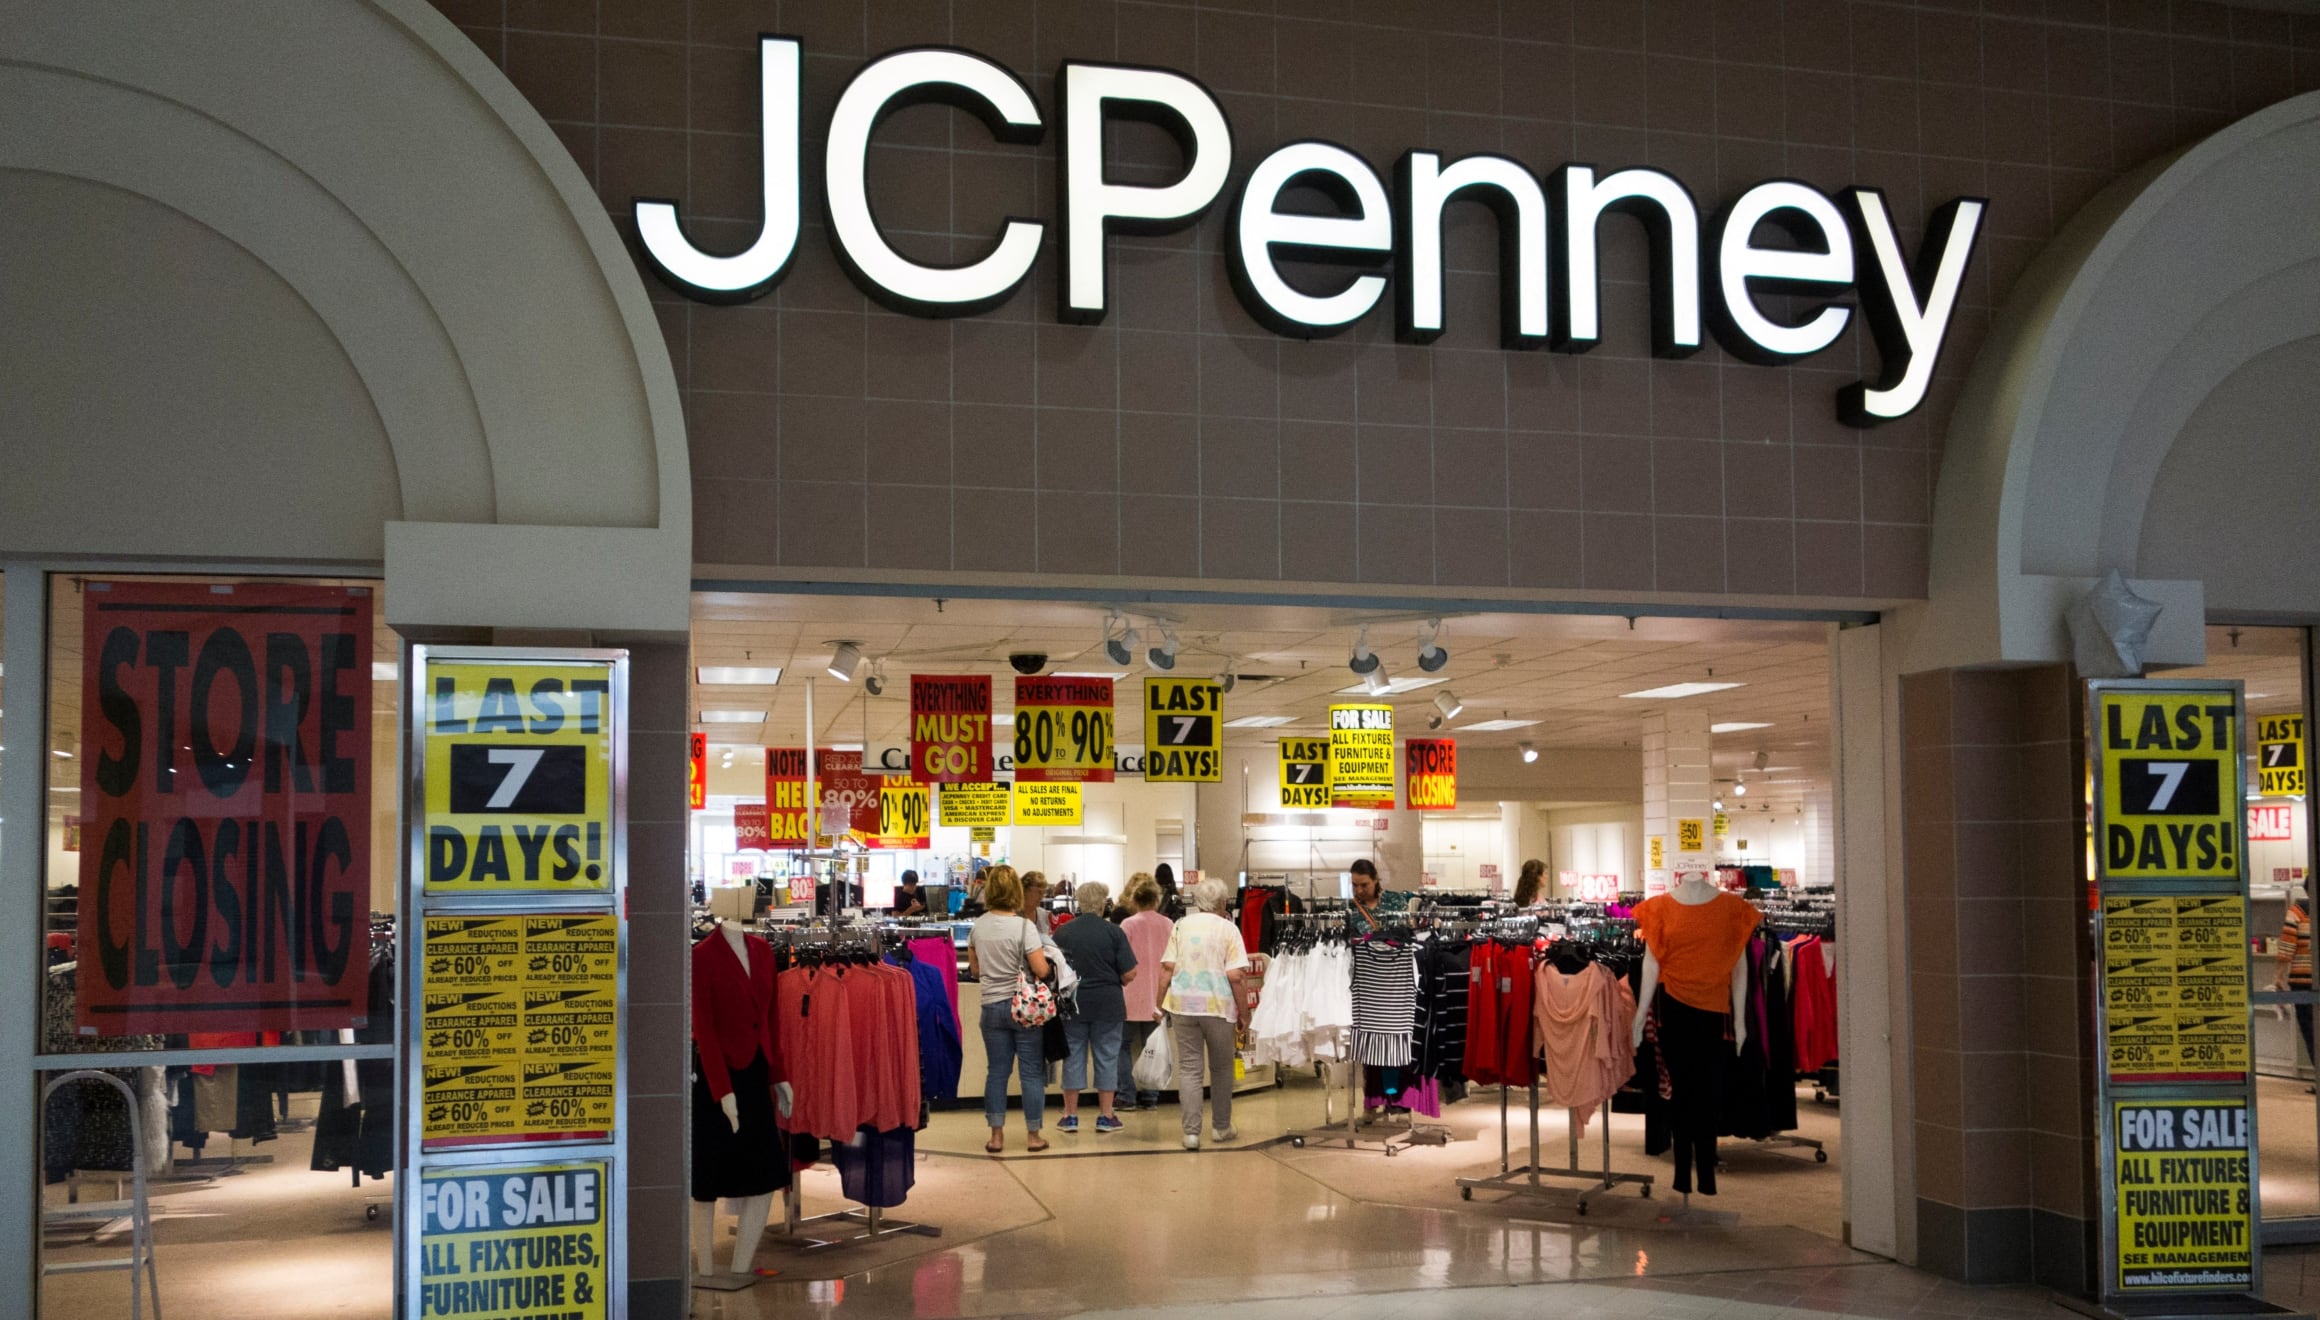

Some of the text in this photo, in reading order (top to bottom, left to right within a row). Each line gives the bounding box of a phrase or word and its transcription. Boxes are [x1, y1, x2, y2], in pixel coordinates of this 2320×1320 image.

[634, 37, 1988, 421] JCPenney
[914, 682, 987, 712] EVERYTHING
[1017, 684, 1110, 701] EVERYTHING
[1150, 685, 1221, 711] LAST
[96, 626, 357, 798] STORE
[435, 677, 609, 735] LAST
[915, 714, 988, 743] MUST
[1332, 710, 1392, 729] FOR SALE
[2107, 704, 2236, 750] LAST
[1172, 716, 1197, 744] 7
[2257, 718, 2304, 741] LAST
[1332, 733, 1349, 745] ALL
[825, 754, 846, 763] RED
[924, 745, 978, 775] GO!
[1282, 742, 1330, 760] LAST
[1334, 748, 1391, 760] FURNITURE &
[1409, 743, 1453, 773] STORE
[2267, 744, 2284, 767] 7
[769, 750, 822, 776] NOTHN
[824, 763, 862, 771] CLEARA
[1149, 750, 1218, 777] DAYS!
[1339, 762, 1389, 774] EQUIPMENT
[484, 748, 546, 809] 7
[1295, 764, 1312, 784] 7
[2259, 769, 2304, 791] DAYS!
[834, 778, 868, 789] 50 TO
[944, 782, 959, 791] WE
[1018, 785, 1078, 794] ALL SALES ARE FINAL
[1409, 774, 1455, 807] CLOSING
[2147, 762, 2190, 811] 7
[824, 789, 878, 809] 80%
[1030, 797, 1066, 806] NO RETURNS
[1282, 787, 1329, 805] DAYS!
[1022, 808, 1074, 817] NO ADJUSTMENTS
[2248, 807, 2290, 838] SALE
[429, 822, 602, 882] DAYS!
[2107, 821, 2233, 870] DAYS!
[97, 816, 354, 991] CLOSING
[427, 920, 464, 931] NEW!
[527, 919, 562, 929] NEW!
[566, 928, 615, 937] REDUCTIONS
[467, 929, 518, 938] REDUCTIONS
[2125, 928, 2151, 943] 60%
[2195, 928, 2221, 943] 60%
[427, 943, 518, 955] CLEARANCE APPAREL
[526, 941, 614, 952] CLEARANCE APPAREL
[454, 956, 490, 975] 60%
[552, 954, 588, 973] 60%
[426, 994, 463, 1005] NEW!
[526, 991, 560, 1002] NEW!
[2126, 987, 2152, 1002] 60%
[2197, 986, 2224, 1001] 60%
[466, 1001, 517, 1011] REDUCTIONS
[564, 999, 613, 1009] REDUCTIONS
[426, 1015, 517, 1029] CLEARANCE APPAREL
[525, 1013, 613, 1026] CLEARANCE APPAREL
[453, 1029, 513, 1048] 60% OFF
[551, 1026, 609, 1045] 60% OFF
[2127, 1046, 2154, 1061] 60%
[2198, 1045, 2225, 1060] 60%
[426, 1067, 462, 1079] NEW!
[524, 1063, 560, 1074] NEW!
[563, 1072, 612, 1080] REDUCTIONS
[465, 1075, 515, 1084] REDUCTIONS
[425, 1088, 515, 1103] CLEARANCE APPAREL
[523, 1085, 612, 1098] CLEARANCE APPAREL
[451, 1102, 488, 1121] 60%
[550, 1098, 608, 1118] 60% OFF
[2121, 1108, 2247, 1149] FOR SALE
[2121, 1159, 2154, 1185] ALL
[422, 1173, 596, 1231] FOR SALE
[2126, 1188, 2249, 1216] FURNITURE &
[2134, 1220, 2244, 1248] EQUIPMENT
[469, 1233, 600, 1273] FIXTURES,
[2123, 1253, 2149, 1265] SEE
[2124, 1270, 2249, 1285] www.hilcofixturefinders.co
[422, 1272, 594, 1316] FURNITURE &
